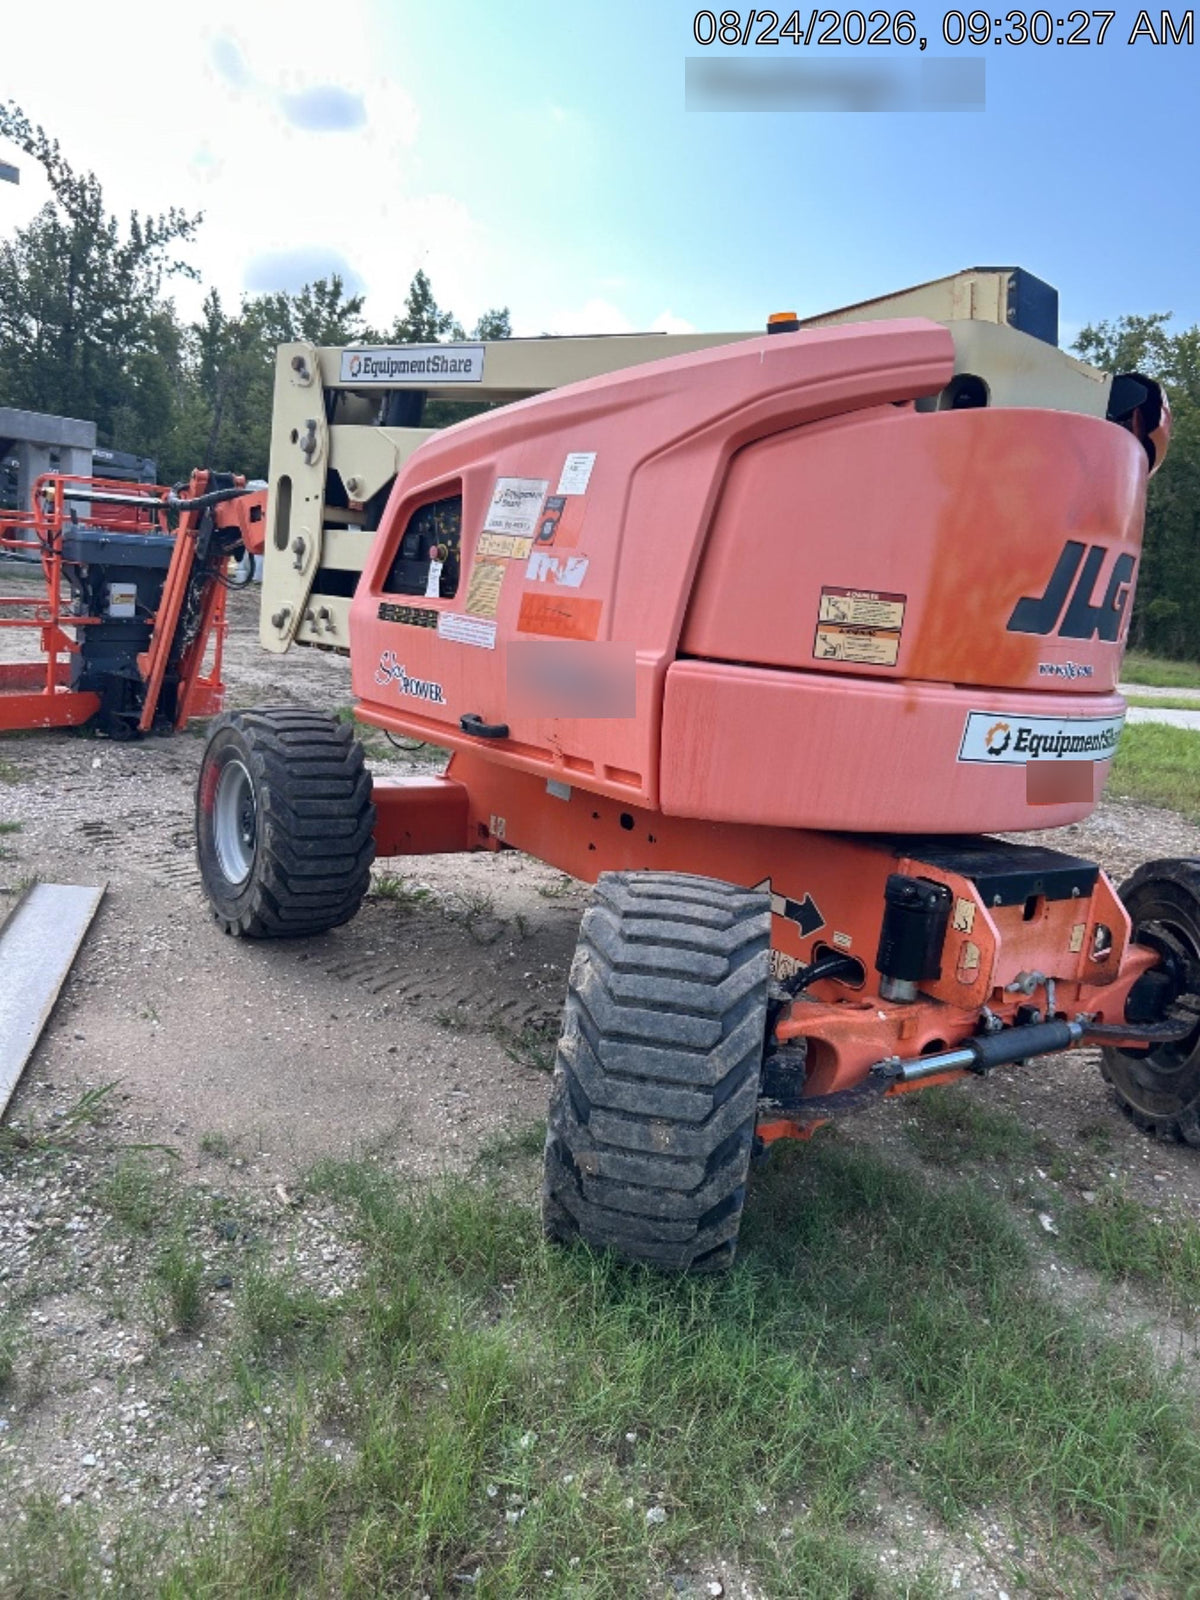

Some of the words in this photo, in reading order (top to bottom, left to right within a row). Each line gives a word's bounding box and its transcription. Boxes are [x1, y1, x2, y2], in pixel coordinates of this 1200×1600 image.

[362, 354, 473, 378] EquipmentShare
[1006, 540, 1136, 642] JLG
[1013, 726, 1121, 758] EquipmentSh
